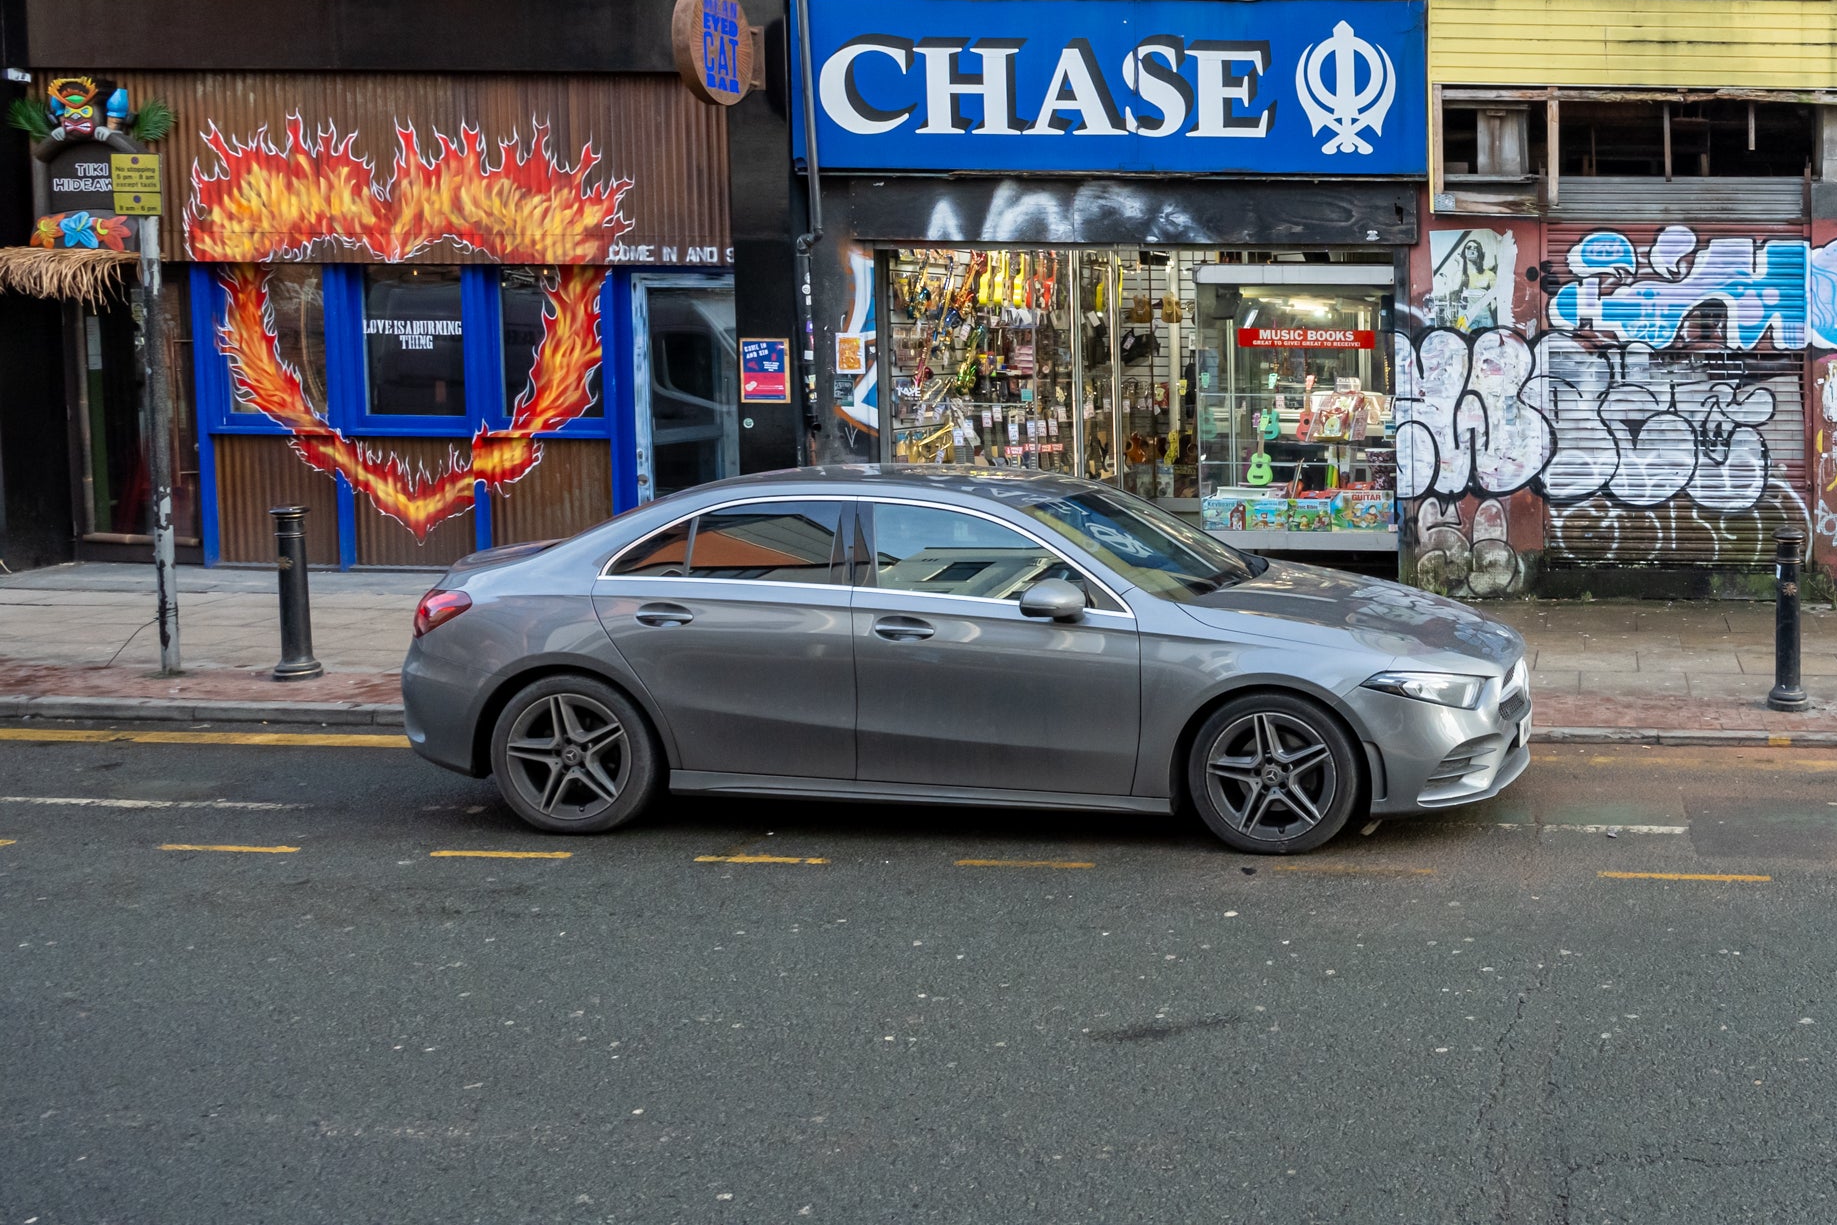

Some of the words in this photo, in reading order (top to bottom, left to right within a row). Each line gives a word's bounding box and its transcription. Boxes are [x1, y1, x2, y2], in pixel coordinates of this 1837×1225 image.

[703, 12, 738, 38] EYED
[703, 31, 739, 78] CAT
[706, 73, 740, 94] BAR
[819, 36, 1274, 138] CHASE
[75, 163, 109, 176] TIKI
[609, 245, 655, 262] COME
[662, 246, 678, 262] IN
[686, 247, 718, 263] AND
[363, 319, 393, 334] LOVE
[412, 320, 462, 335] BURNING
[1259, 329, 1304, 340] MUSIC
[1307, 330, 1354, 341] BOOKS
[400, 335, 433, 350] THING
